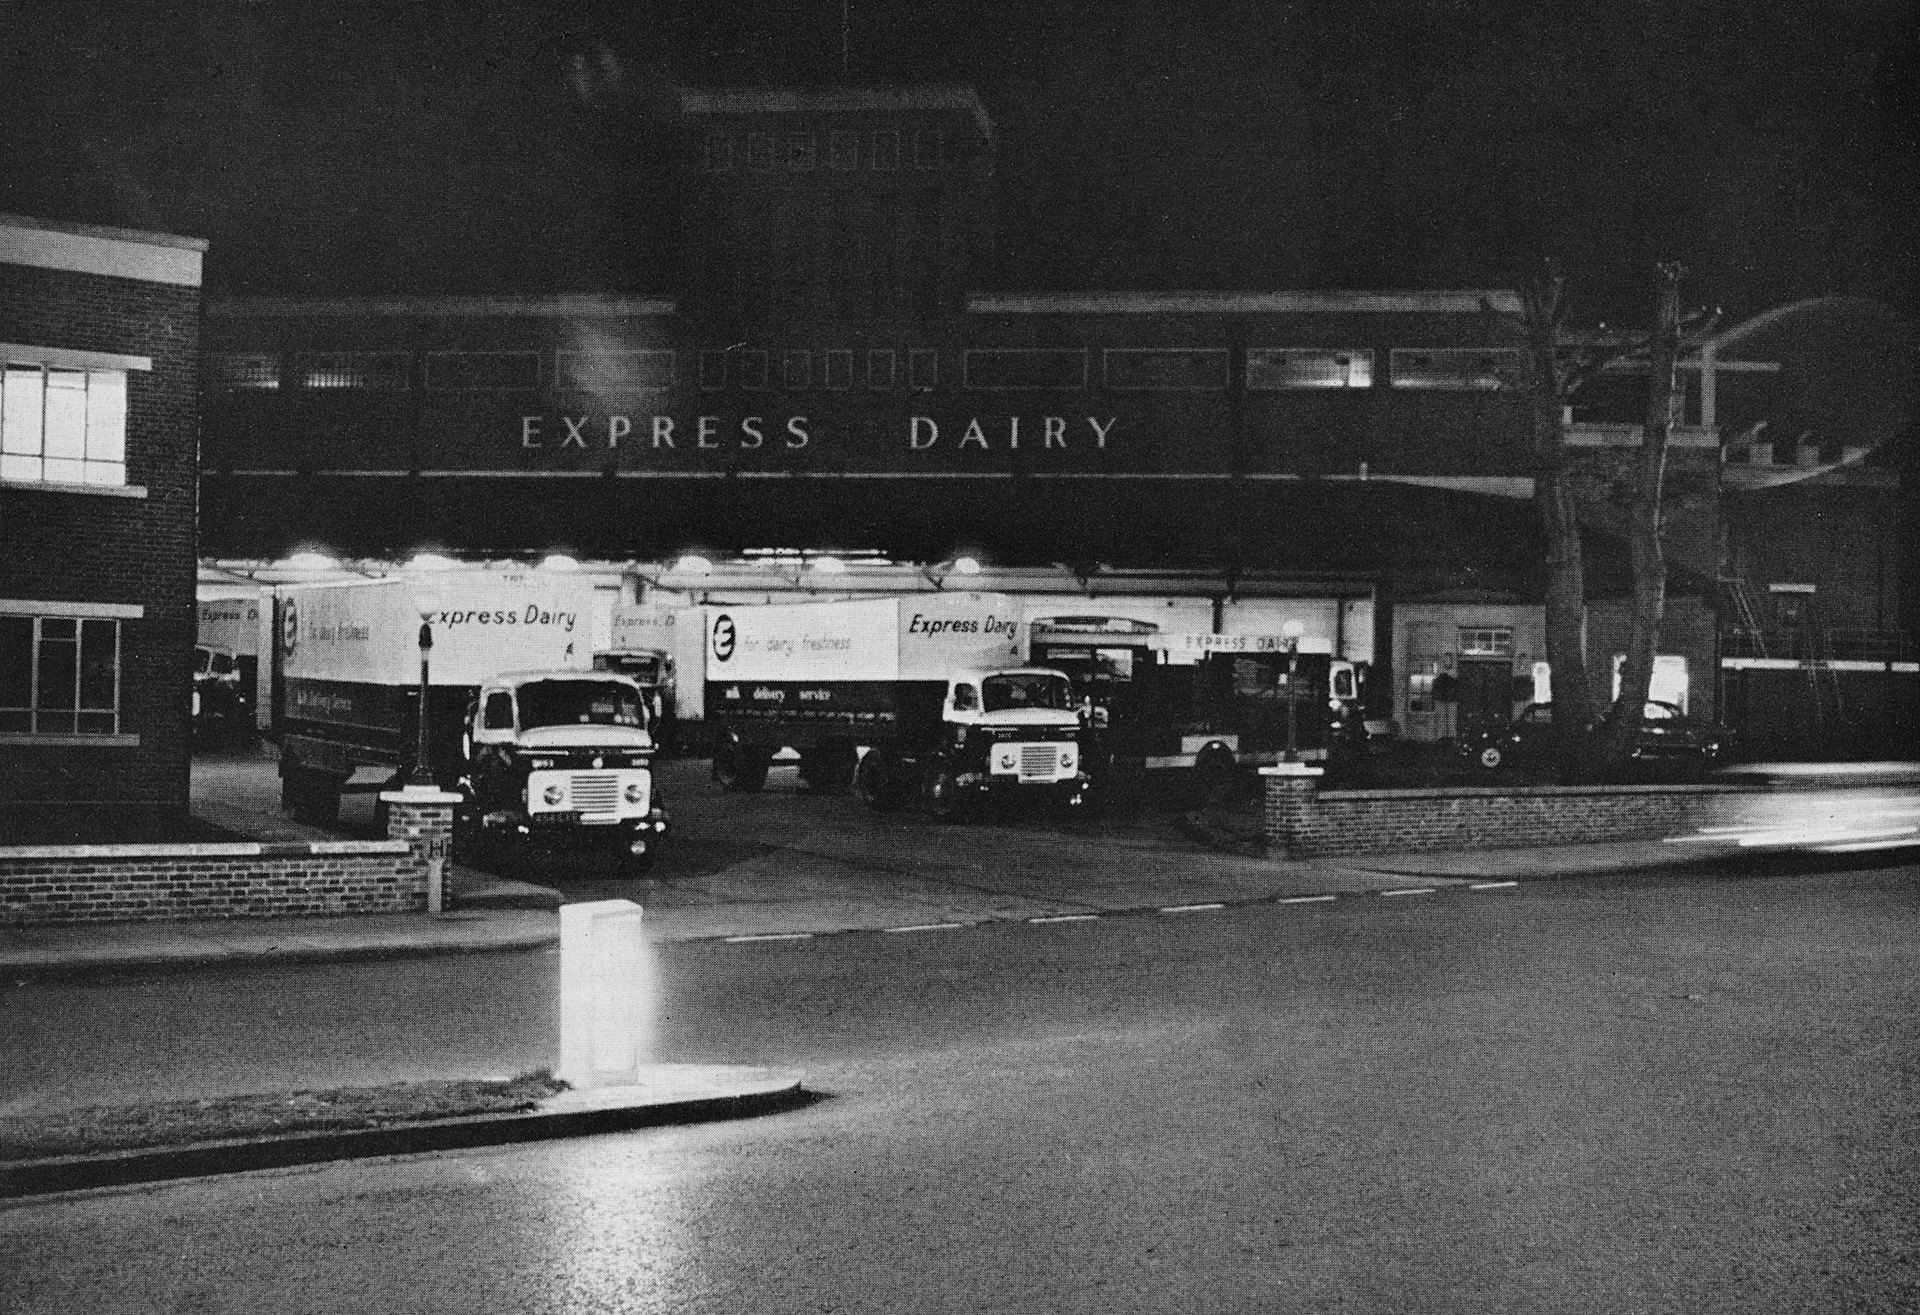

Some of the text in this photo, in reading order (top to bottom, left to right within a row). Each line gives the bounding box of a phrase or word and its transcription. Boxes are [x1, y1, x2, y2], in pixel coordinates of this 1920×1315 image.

[522, 415, 1117, 449] EXPRESS DAIRY
[523, 604, 577, 632] Dairy
[908, 613, 979, 638] Express
[984, 615, 1018, 640] Dairy
[1185, 635, 1247, 650] EXPRESS
